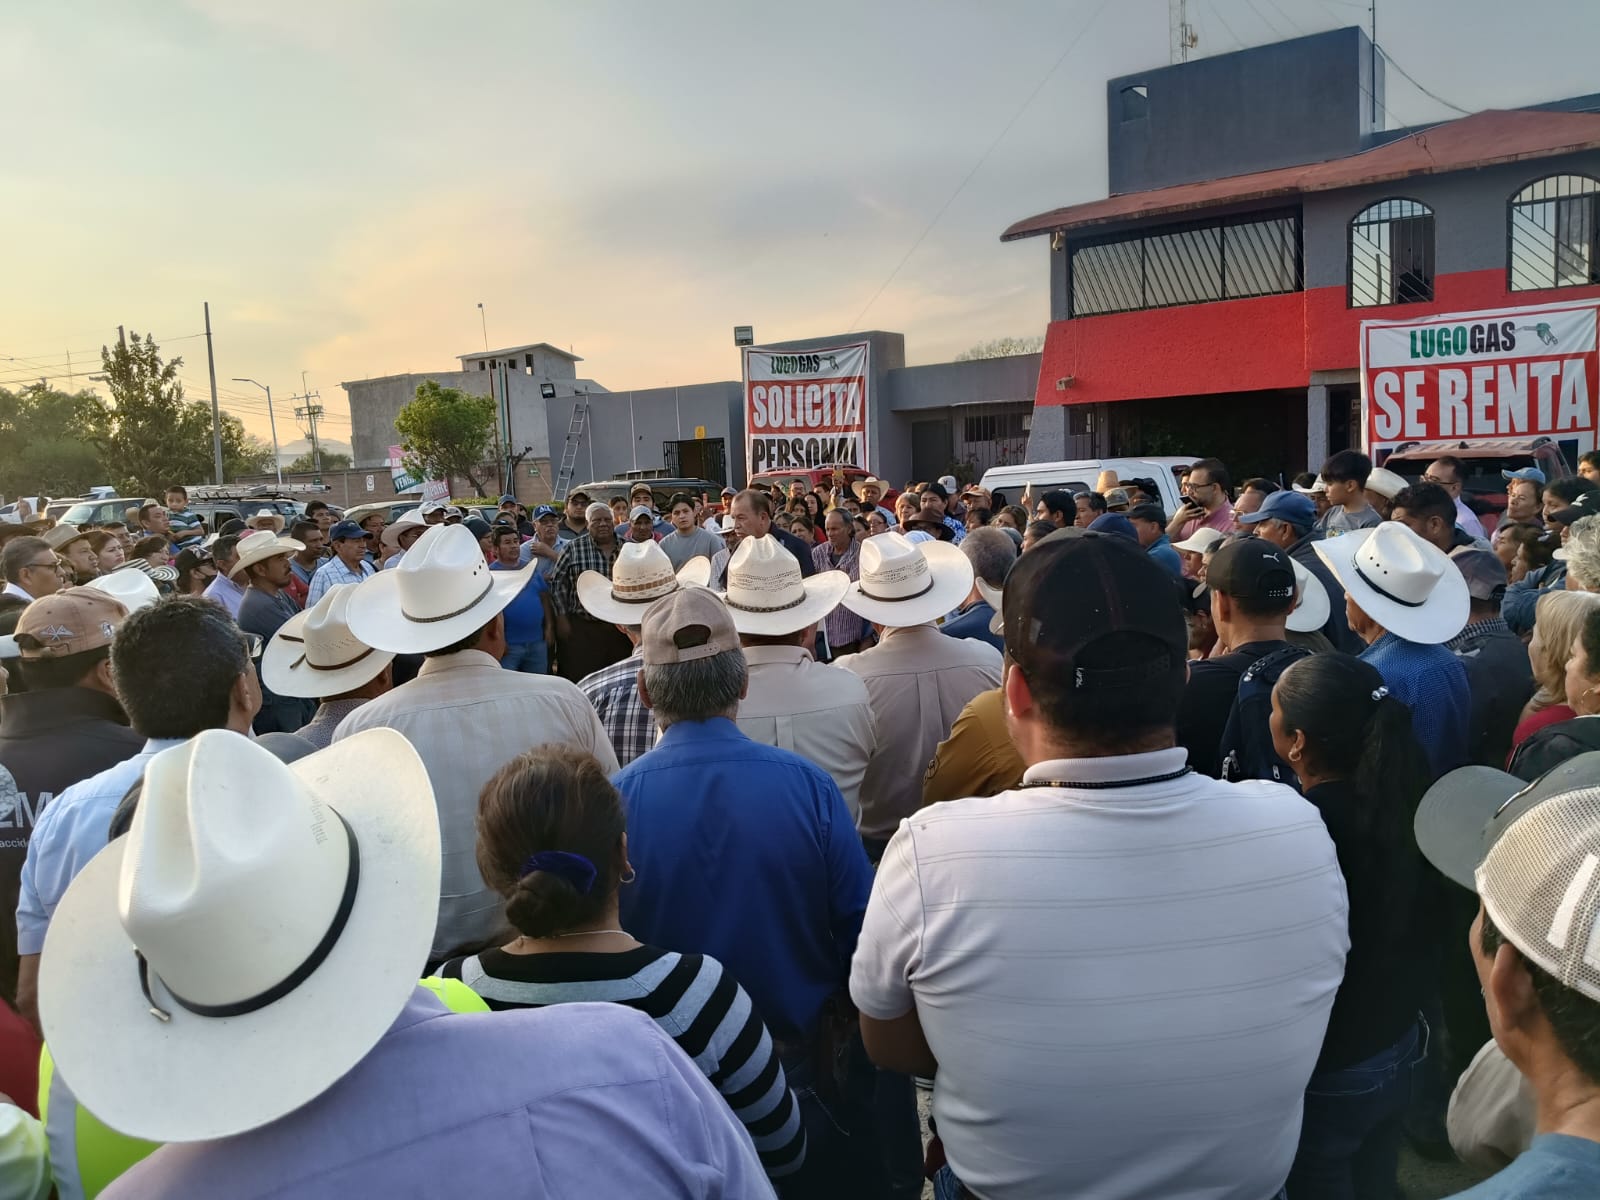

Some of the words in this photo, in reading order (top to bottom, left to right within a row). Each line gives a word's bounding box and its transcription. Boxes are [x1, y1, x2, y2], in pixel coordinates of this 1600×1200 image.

[1410, 321, 1516, 359] LUGOGAS
[771, 354, 820, 374] LUGOGAS
[752, 383, 861, 428] SOLICITA
[1373, 370, 1427, 440] SE
[1438, 358, 1591, 436] RENTA
